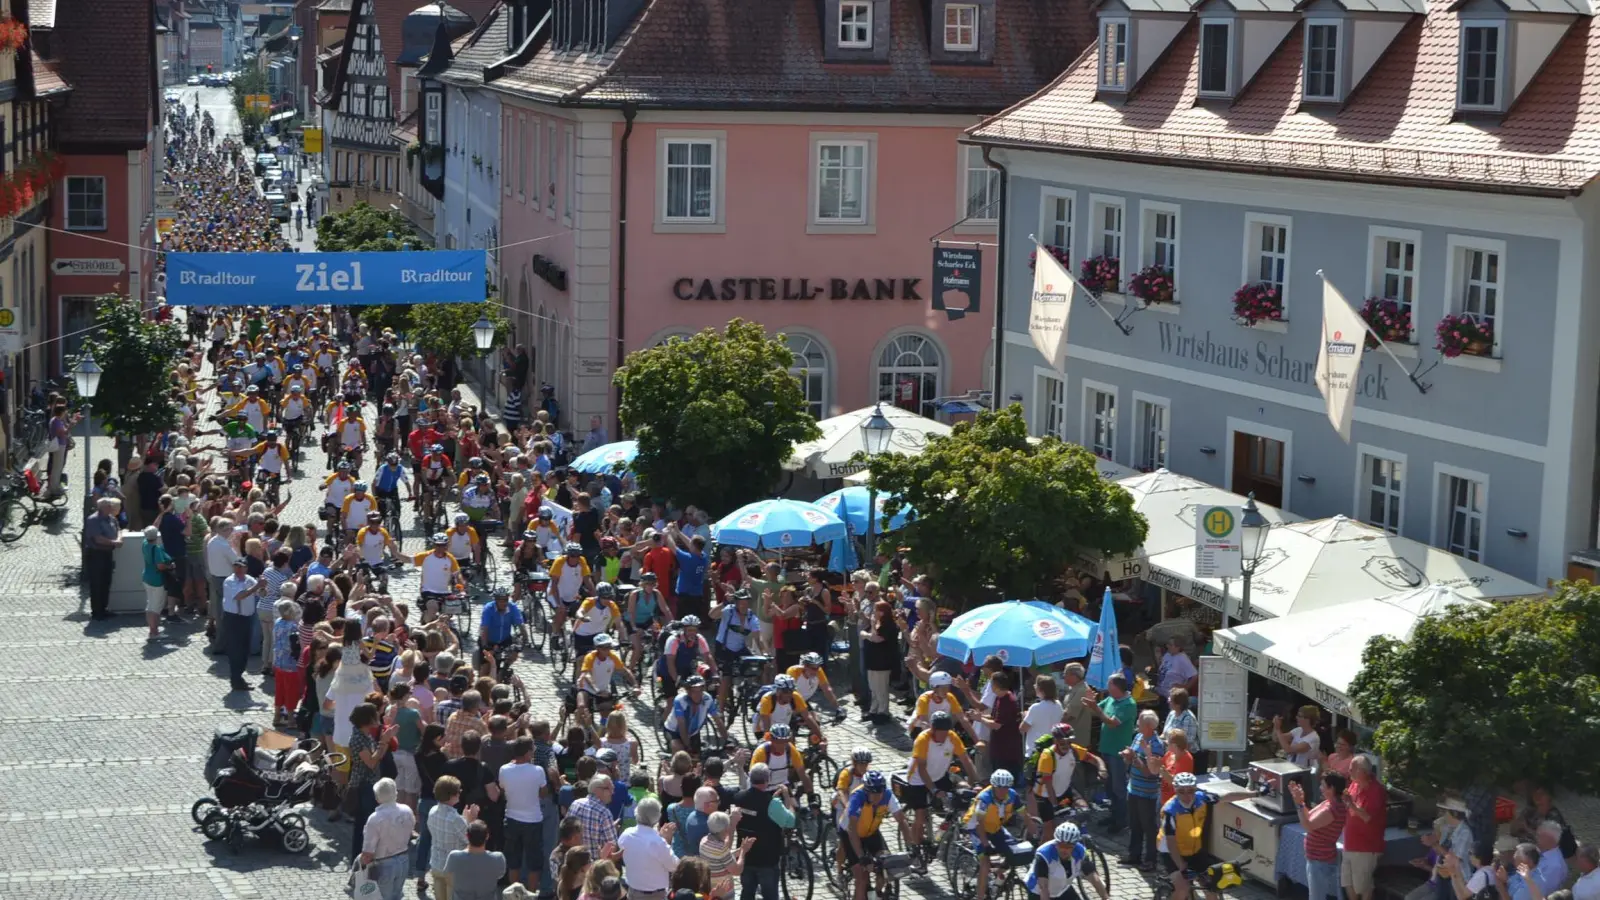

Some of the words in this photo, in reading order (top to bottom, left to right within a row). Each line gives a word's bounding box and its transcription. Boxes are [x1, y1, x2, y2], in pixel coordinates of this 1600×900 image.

[942, 251, 973, 260] Wirtshaus
[964, 261, 976, 269] Eck
[295, 261, 364, 291] Ziel
[943, 276, 970, 285] Hofmann
[673, 278, 922, 301] CASTELL-BANK
[1158, 321, 1248, 371] Wirtshaus
[1255, 340, 1316, 386] Schar
[830, 462, 867, 476] Hofma
[1212, 513, 1225, 531] H
[1148, 565, 1181, 590] Hofmann
[1221, 639, 1259, 668] Hofmann
[1266, 658, 1304, 690] Hofmann
